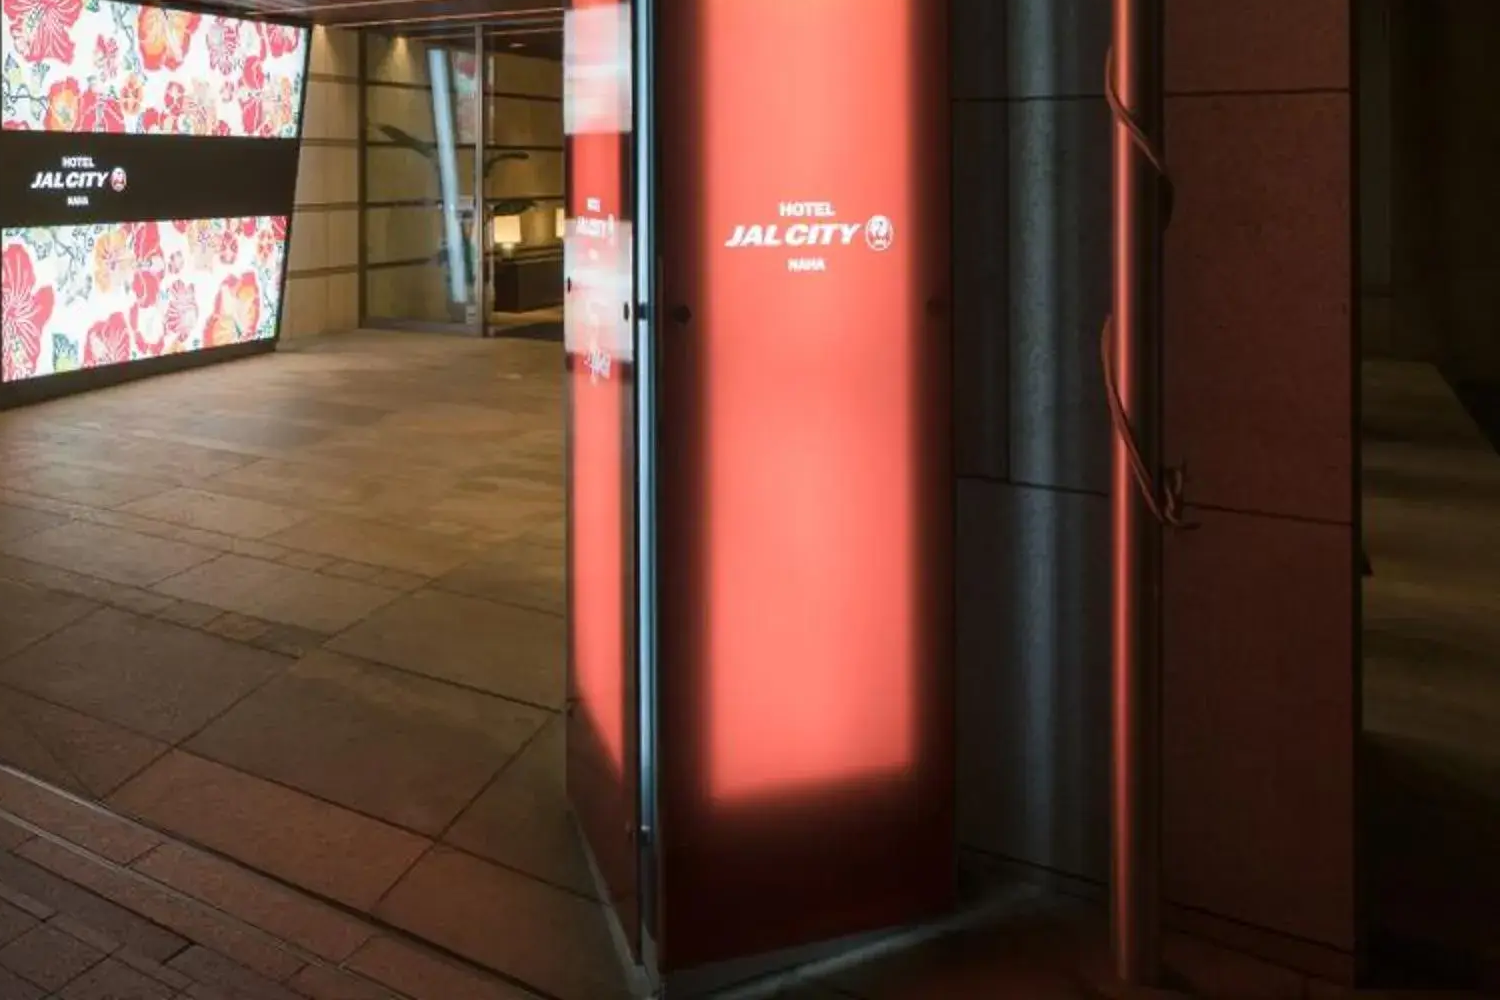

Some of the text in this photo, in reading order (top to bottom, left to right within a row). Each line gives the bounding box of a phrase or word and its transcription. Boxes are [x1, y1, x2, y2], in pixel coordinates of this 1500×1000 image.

[61, 155, 96, 169] HOTEL
[30, 170, 110, 189] JAL CITY
[778, 200, 836, 218] HOTEL
[724, 222, 861, 248] JAL CITY
[786, 256, 827, 273] NAHA
